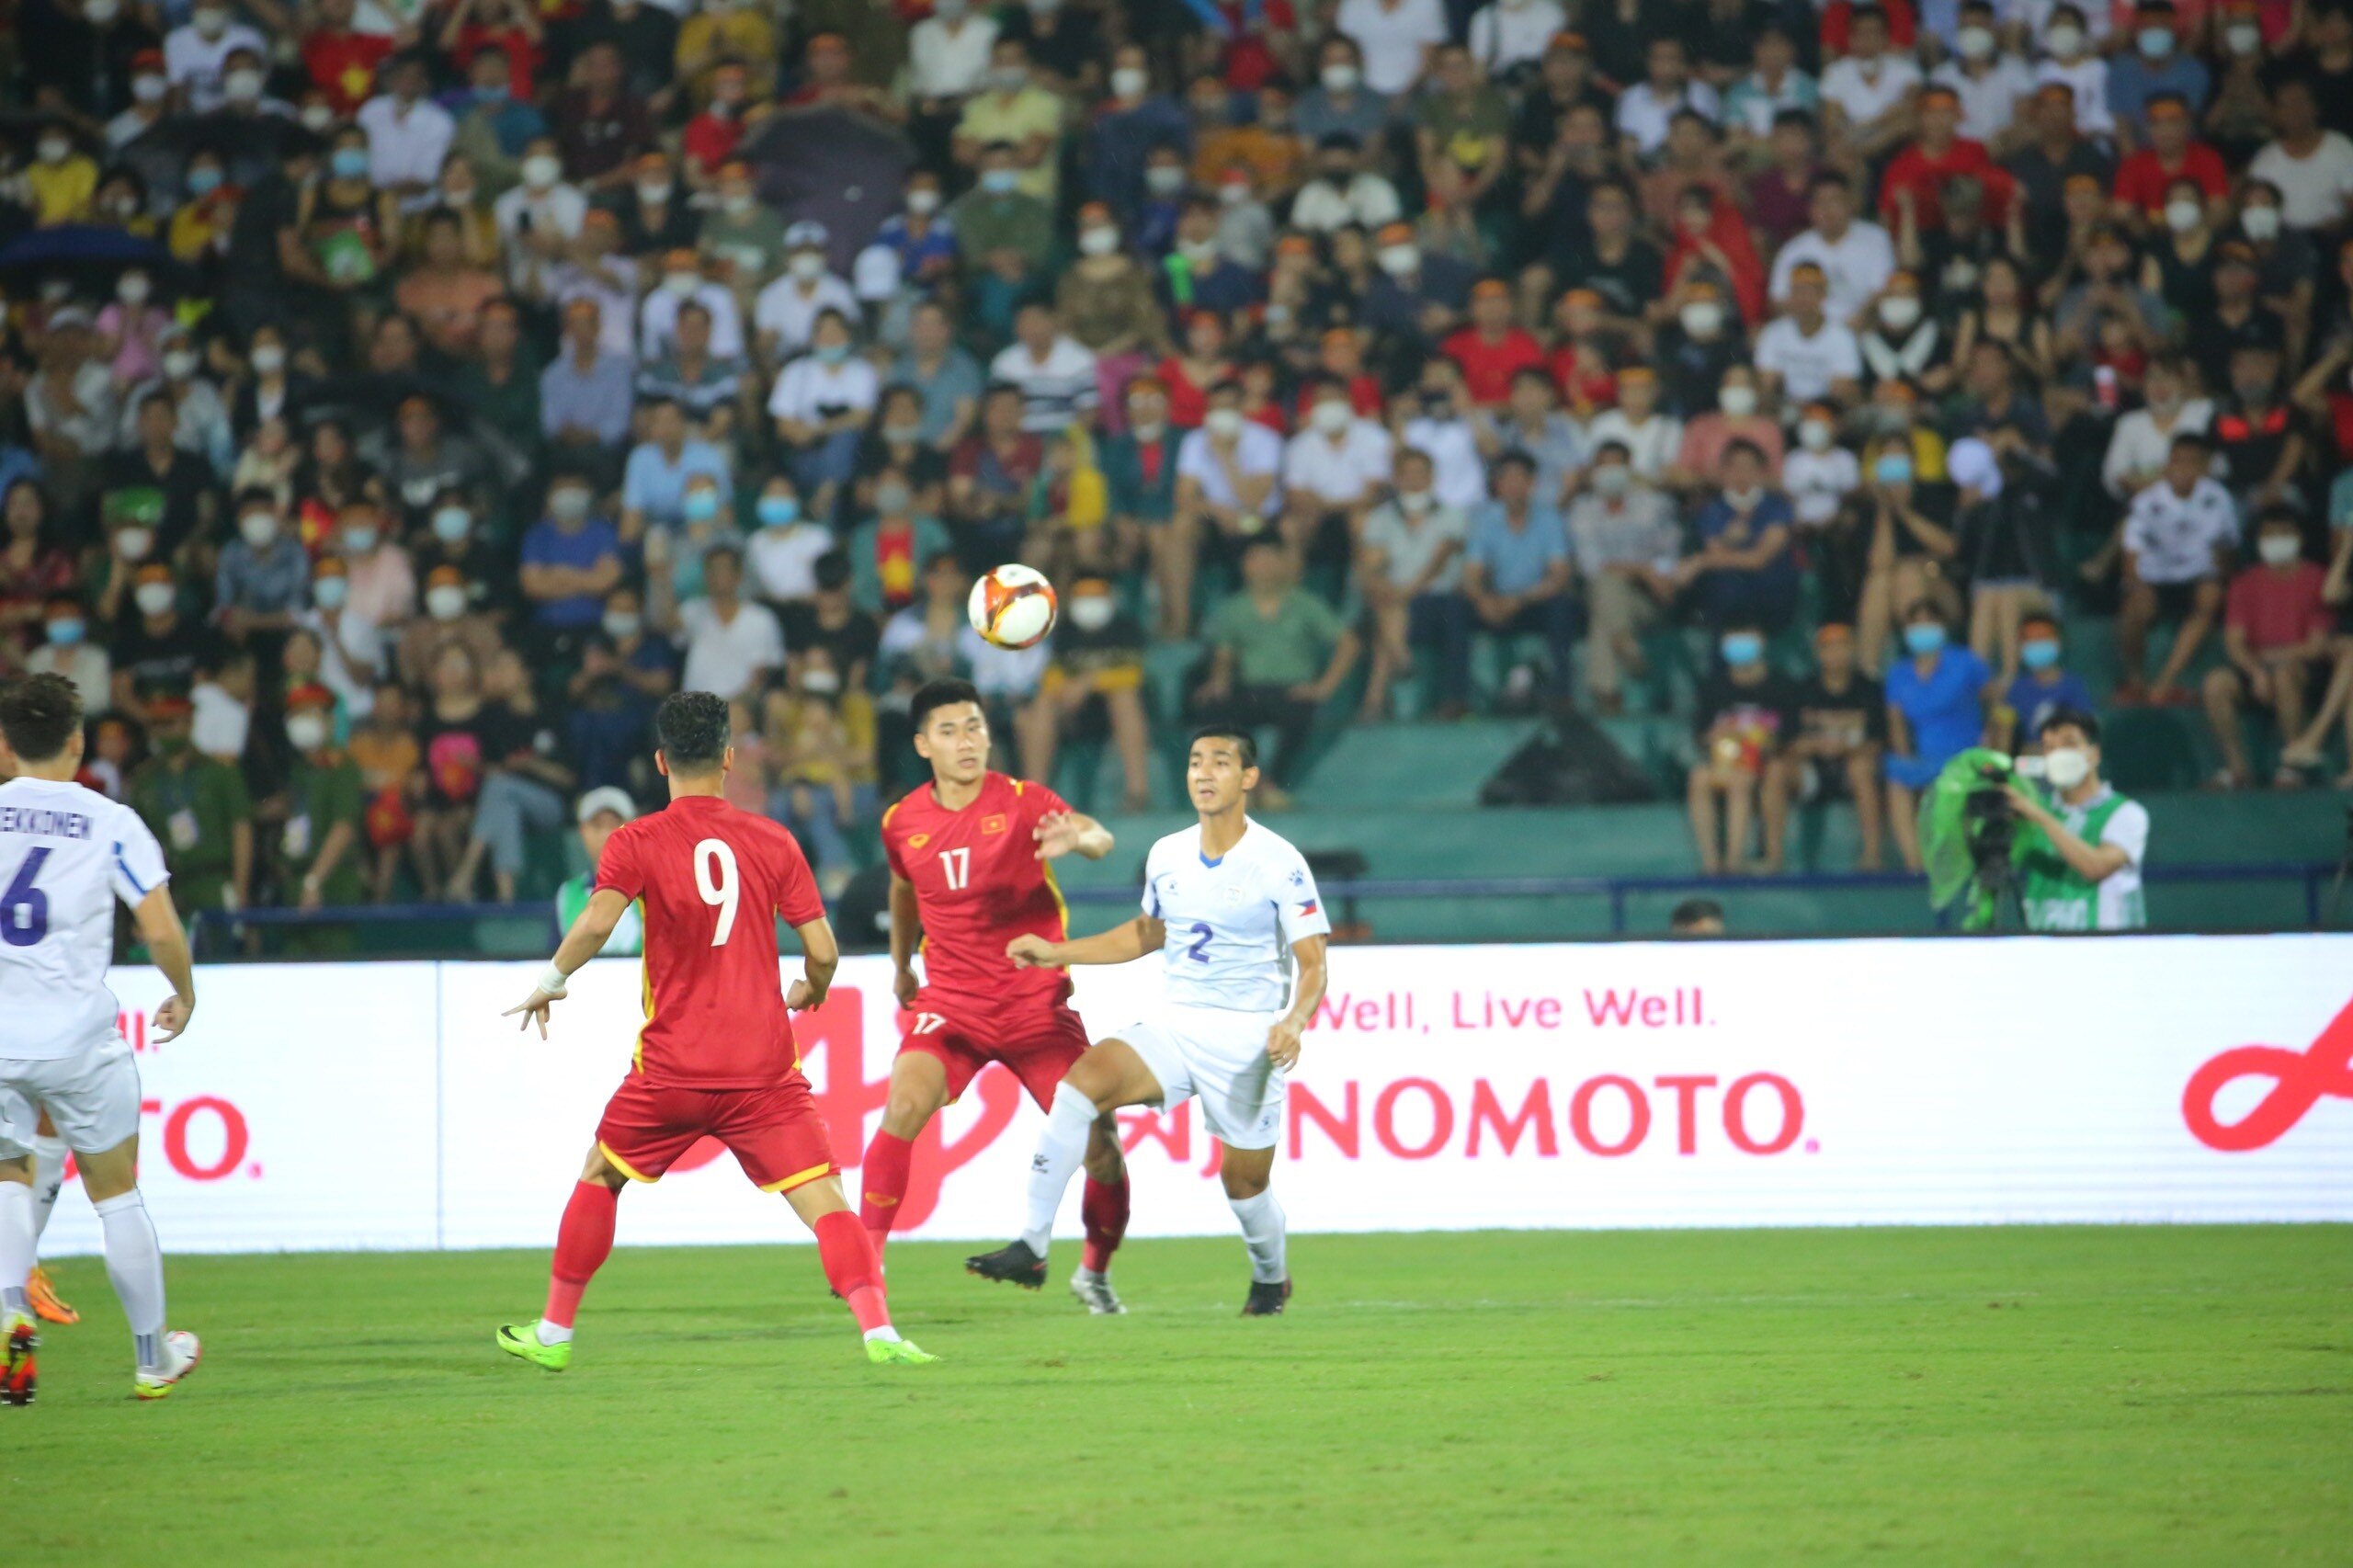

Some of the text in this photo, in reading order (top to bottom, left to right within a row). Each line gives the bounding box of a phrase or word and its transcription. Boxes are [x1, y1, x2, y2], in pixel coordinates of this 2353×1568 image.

[938, 846, 971, 891] 17
[0, 846, 54, 947] 6
[694, 837, 740, 948] 9
[1188, 922, 1214, 963] 2
[912, 1012, 947, 1035] 17
[1306, 986, 1717, 1035] Well, Live Well.
